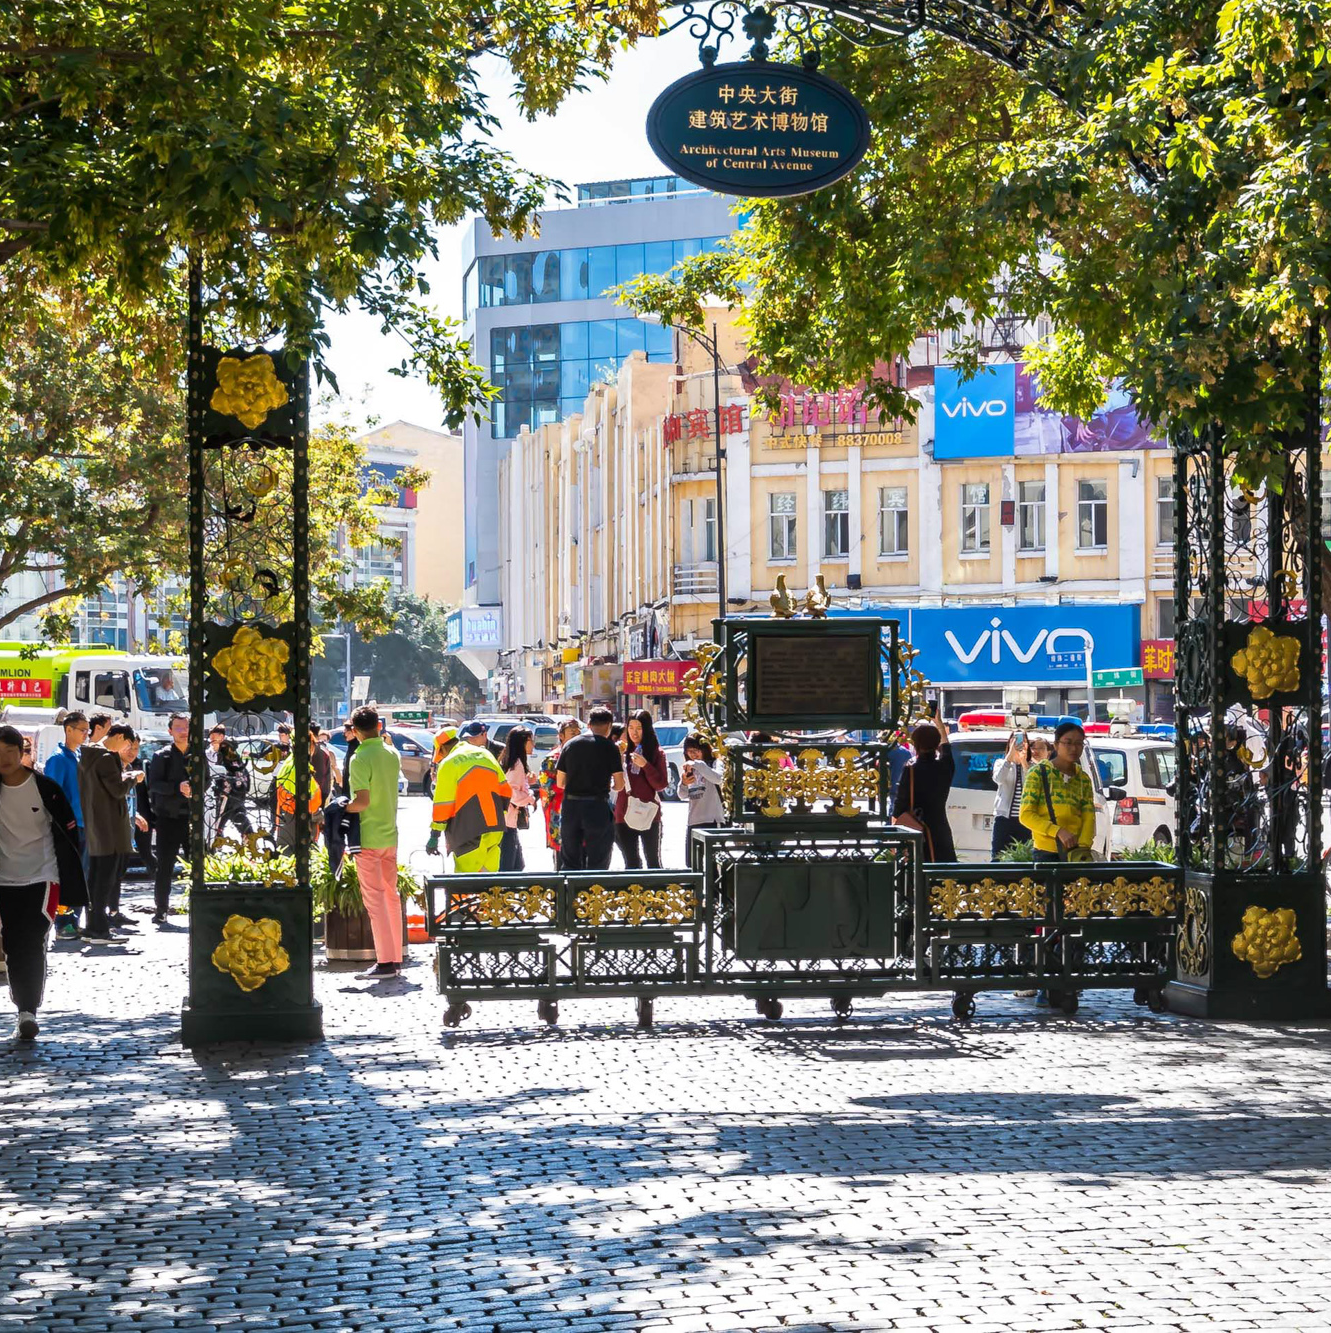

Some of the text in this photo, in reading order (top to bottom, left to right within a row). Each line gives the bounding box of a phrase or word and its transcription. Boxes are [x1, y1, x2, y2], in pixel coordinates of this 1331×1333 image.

[718, 84, 798, 106] 中央大街
[688, 109, 829, 133] 建筑艺术博物馆
[680, 144, 839, 159] Architectural Arts Museum
[706, 158, 813, 171] of Central Avenue
[941, 397, 1007, 418] vivo
[765, 432, 903, 449] 中式快餐 88370008
[944, 617, 1095, 664] vivo
